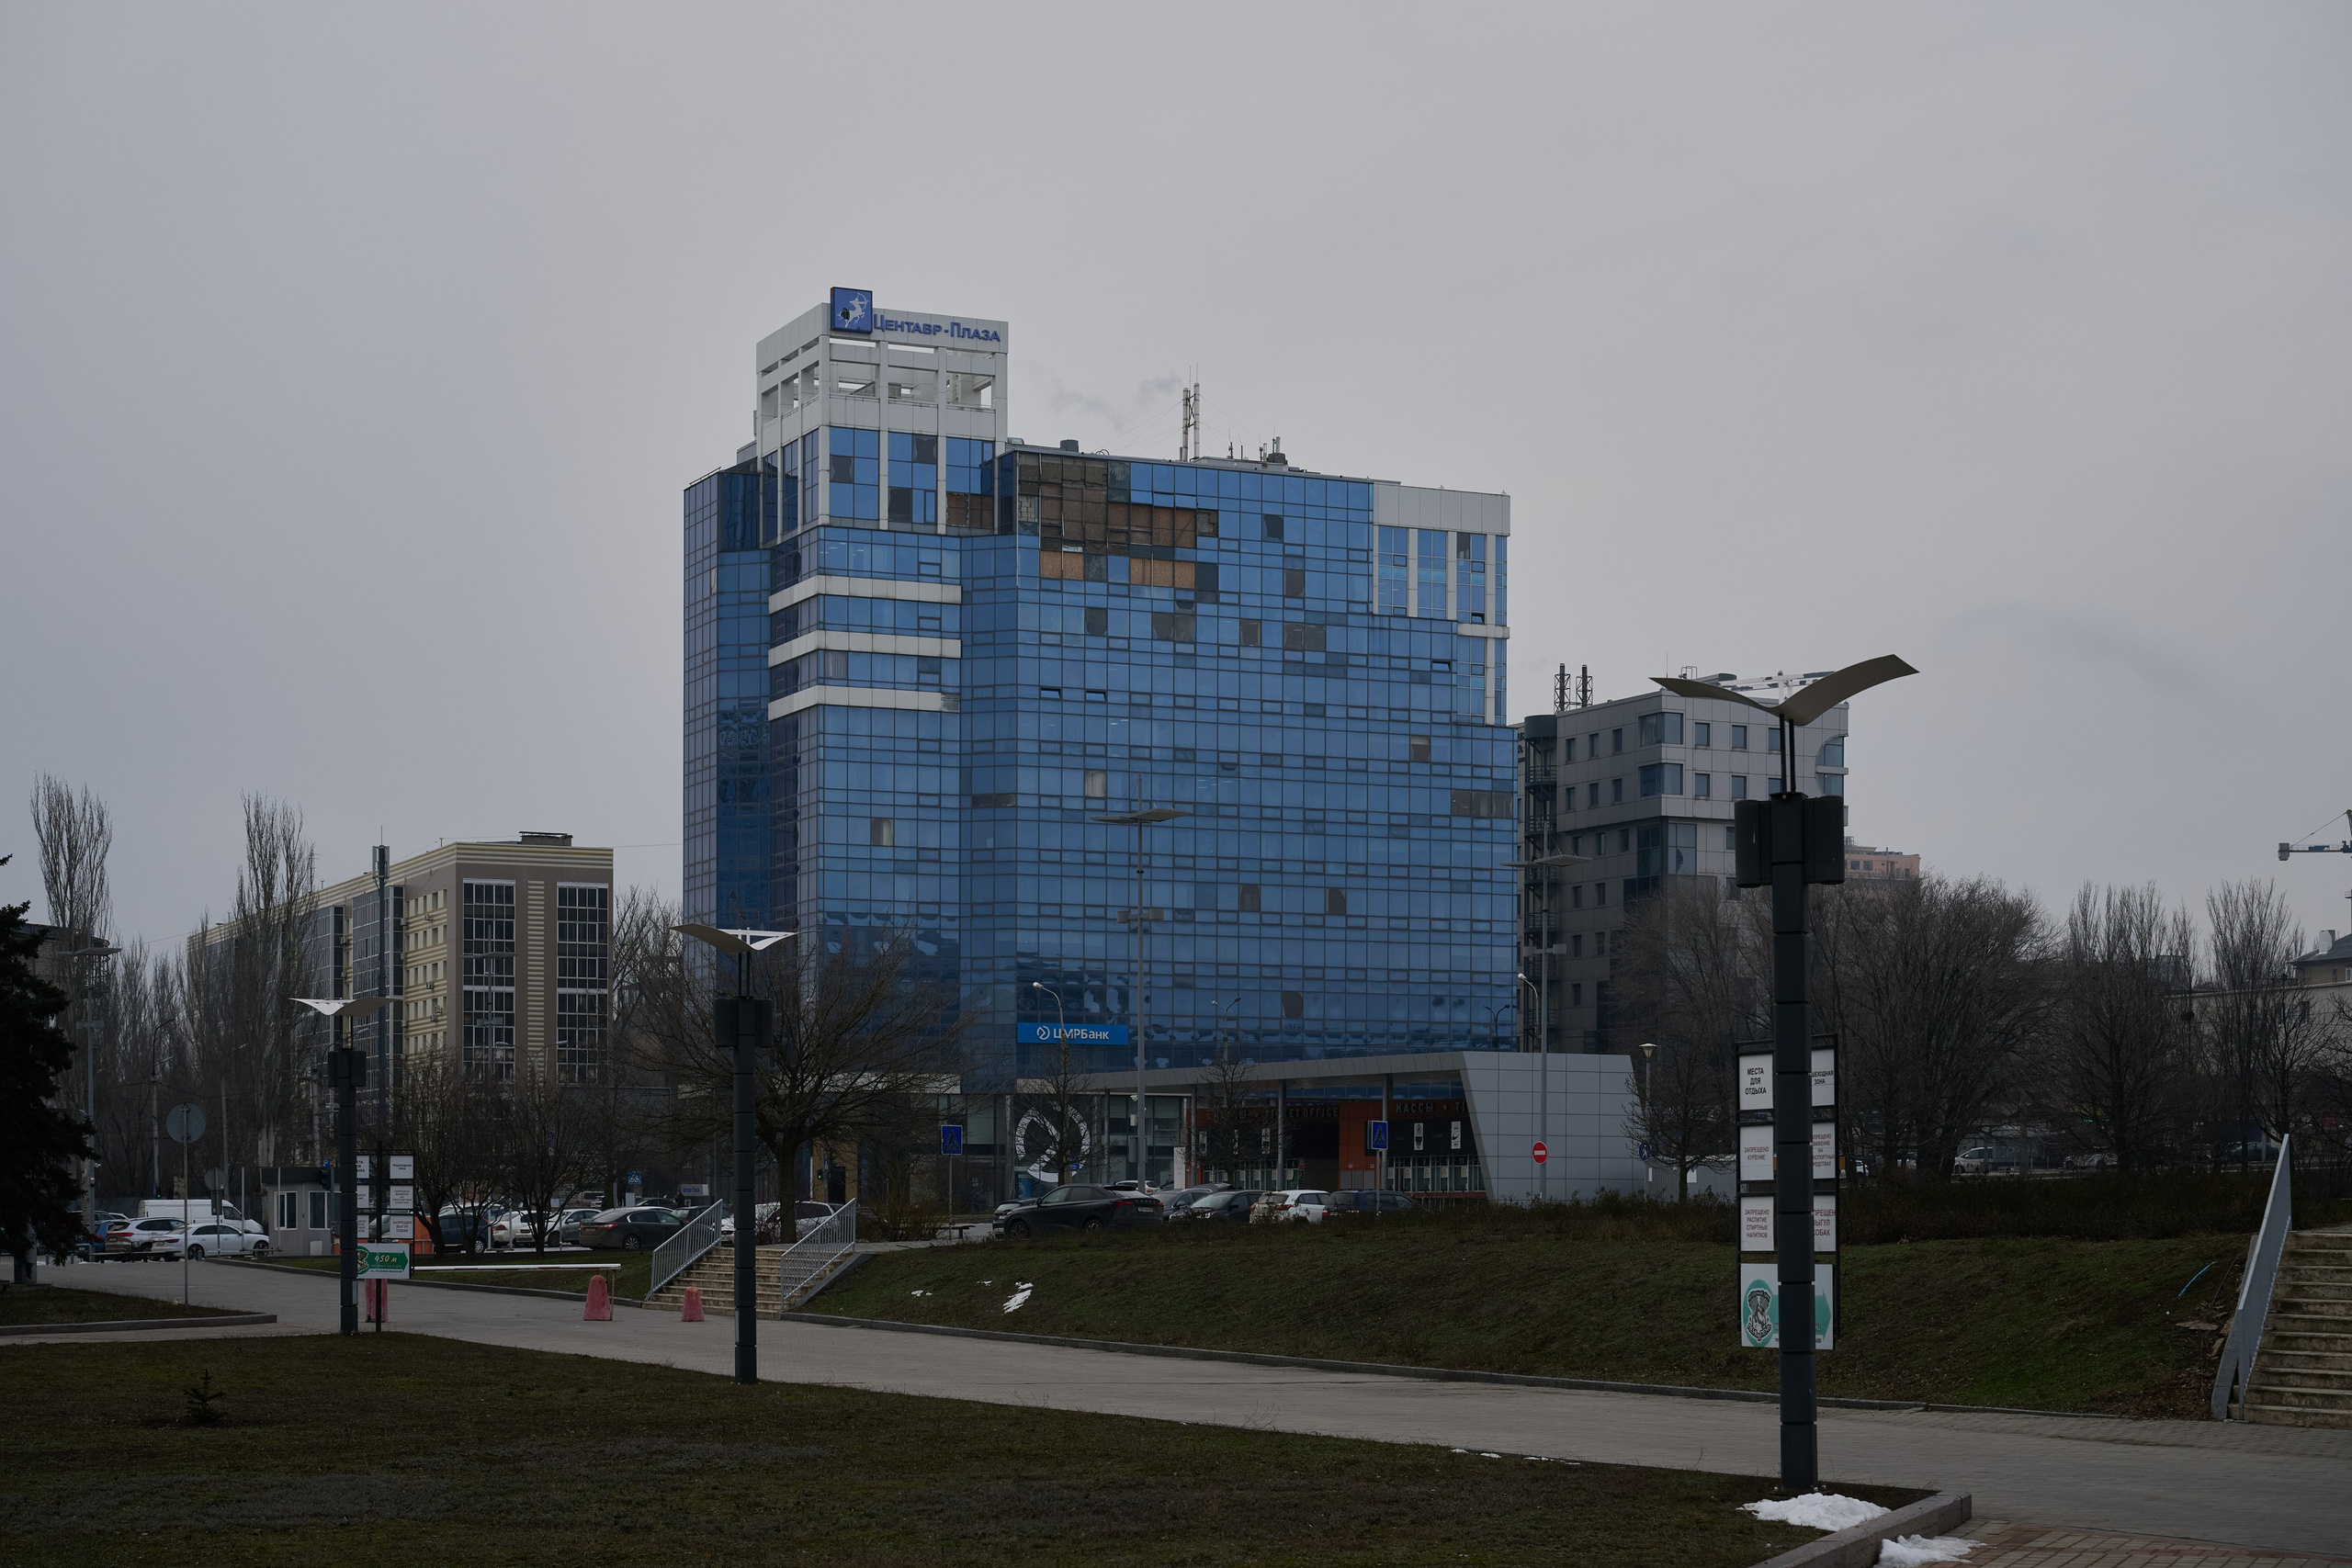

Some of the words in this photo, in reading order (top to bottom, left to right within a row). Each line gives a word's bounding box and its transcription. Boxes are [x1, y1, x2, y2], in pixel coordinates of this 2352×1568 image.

[1053, 1028, 1109, 1040] ЦМРБанк
[1747, 1067, 1765, 1076] МЕСТА
[1750, 1077, 1761, 1086] ДЛЯ
[1745, 1087, 1767, 1095] ОТДЫХА
[1303, 1107, 1339, 1118] OFFICE
[1396, 1102, 1434, 1114] КАССЫ
[374, 1254, 390, 1264] 450
